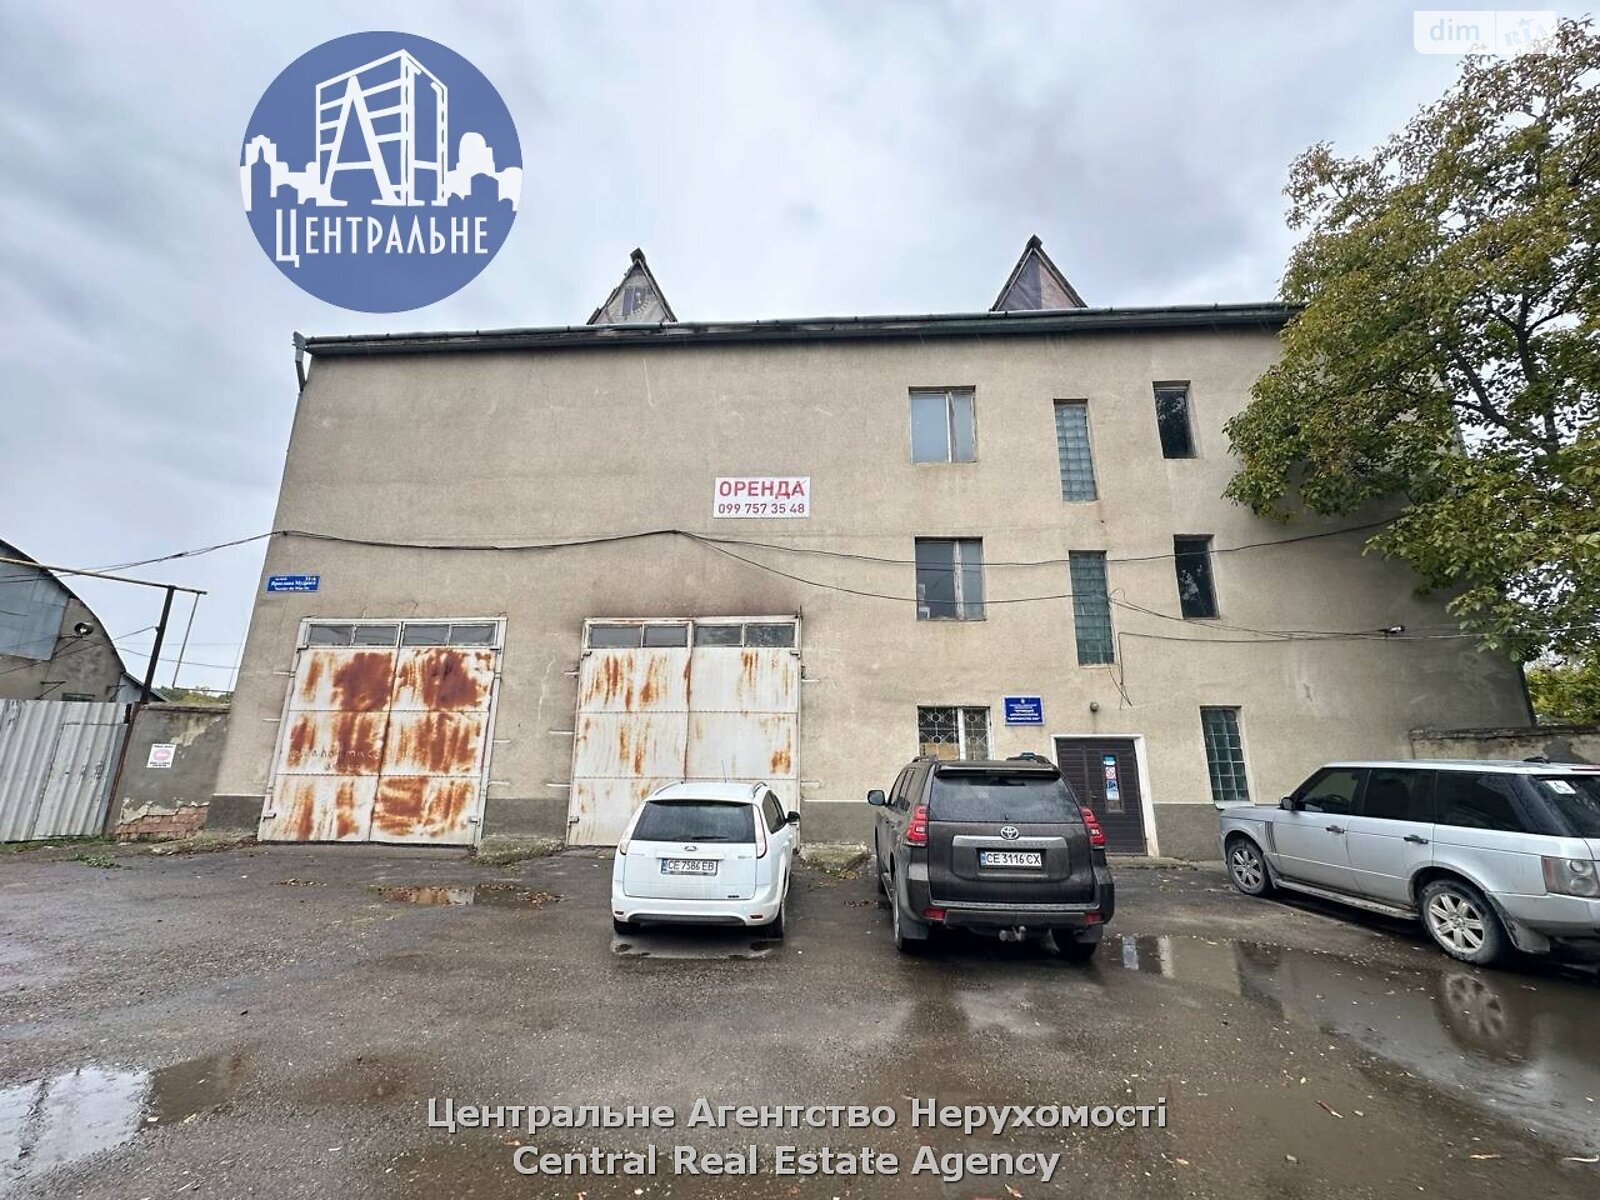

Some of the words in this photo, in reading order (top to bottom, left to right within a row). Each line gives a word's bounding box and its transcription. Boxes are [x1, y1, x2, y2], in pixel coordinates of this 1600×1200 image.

[719, 481, 805, 499] ОРЕНДА
[718, 503, 741, 514] 099
[745, 503, 767, 514] 757
[771, 503, 786, 514] 35
[789, 503, 805, 514] 48
[986, 853, 1000, 864] CE
[1002, 854, 1024, 865] 3116
[1026, 854, 1041, 865] CX
[681, 860, 701, 871] 7586
